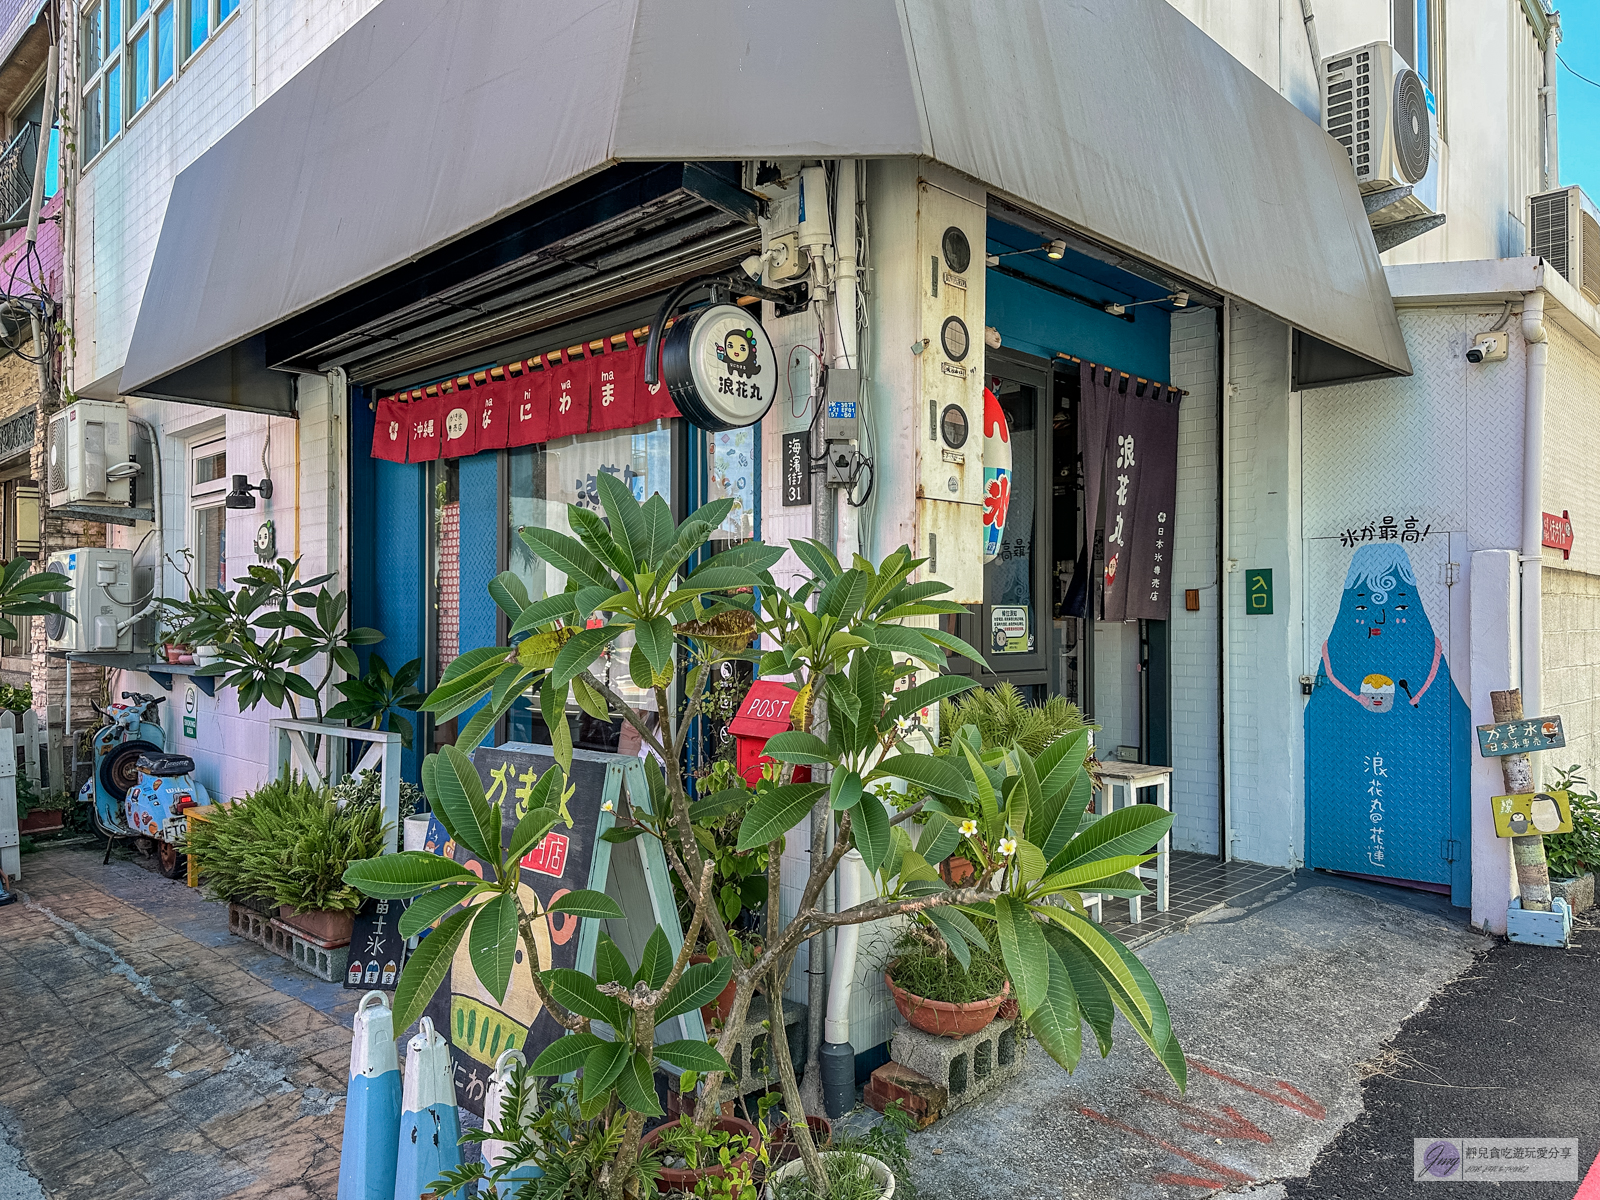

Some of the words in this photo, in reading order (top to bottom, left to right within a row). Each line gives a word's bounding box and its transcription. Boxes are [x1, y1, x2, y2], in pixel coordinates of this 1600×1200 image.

[560, 379, 572, 391] wa
[601, 370, 615, 382] ma
[718, 376, 763, 401] 浪花丸
[413, 419, 435, 440] 沖縄
[1108, 434, 1136, 547] 浪花丸
[1340, 515, 1431, 548] 氷が最高!
[1251, 576, 1268, 608] 入口
[747, 698, 790, 718] POST
[1486, 722, 1538, 743] かき氷
[1363, 751, 1388, 868] 浪花丸@花蓮
